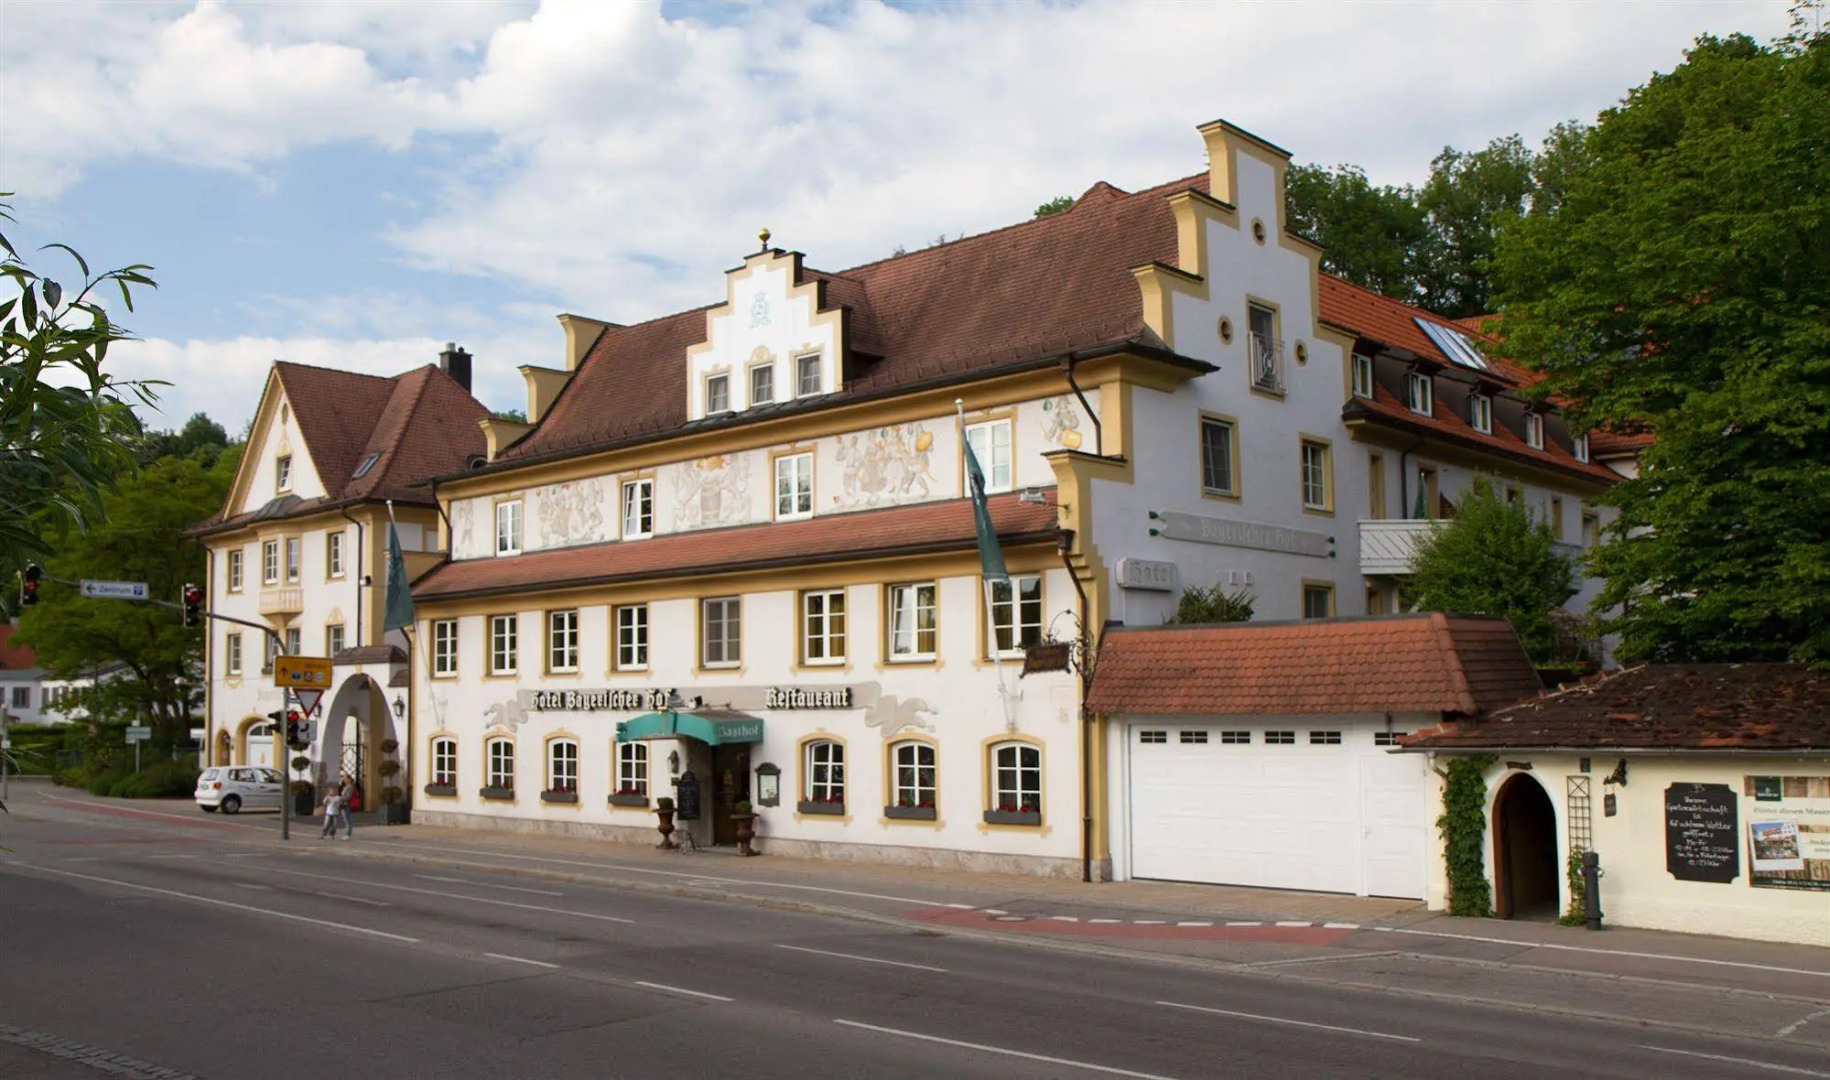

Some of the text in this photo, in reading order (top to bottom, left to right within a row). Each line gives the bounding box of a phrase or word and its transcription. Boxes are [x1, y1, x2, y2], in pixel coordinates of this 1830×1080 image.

[1129, 562, 1175, 584] Hotel
[99, 585, 131, 593] Zentrum
[531, 690, 563, 711] Hotel
[645, 687, 673, 711] Hof
[764, 686, 850, 710] Restaurant
[718, 724, 760, 738] Gasthof
